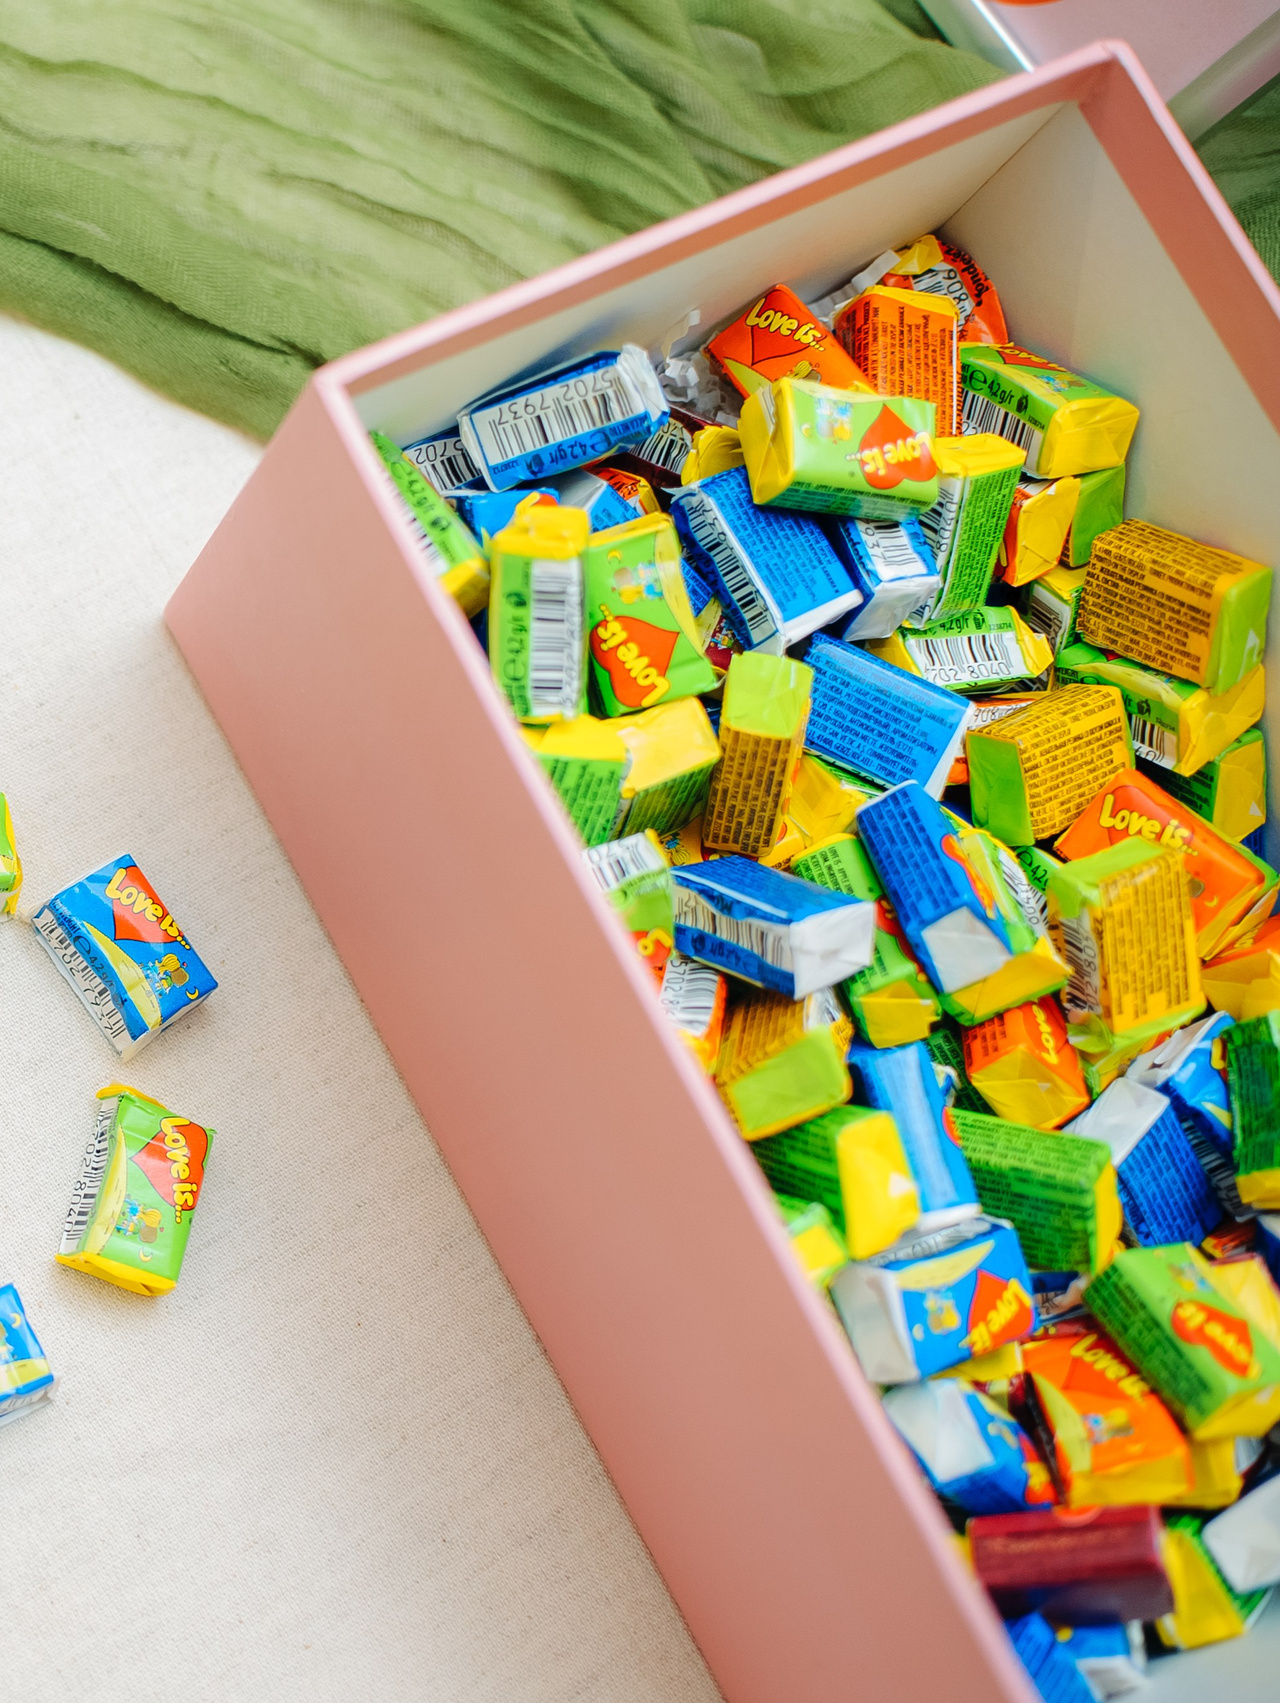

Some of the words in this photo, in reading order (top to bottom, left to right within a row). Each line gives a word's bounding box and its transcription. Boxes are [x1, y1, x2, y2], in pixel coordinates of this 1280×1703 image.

[745, 298, 800, 336] Love
[794, 322, 825, 352] is...
[563, 371, 614, 400] 5702
[988, 378, 1001, 396] 4,2
[498, 392, 551, 425] 7937
[883, 432, 936, 465] Love
[596, 604, 628, 652] is...
[616, 641, 670, 708] Love
[968, 662, 1012, 680] 8040
[1099, 793, 1161, 840] Love
[1159, 818, 1198, 857] is...
[104, 867, 164, 922] Love
[88, 955, 103, 972] 4,2
[663, 959, 688, 1001] 5702
[160, 1117, 192, 1181] Love
[172, 1182, 198, 1224] is...
